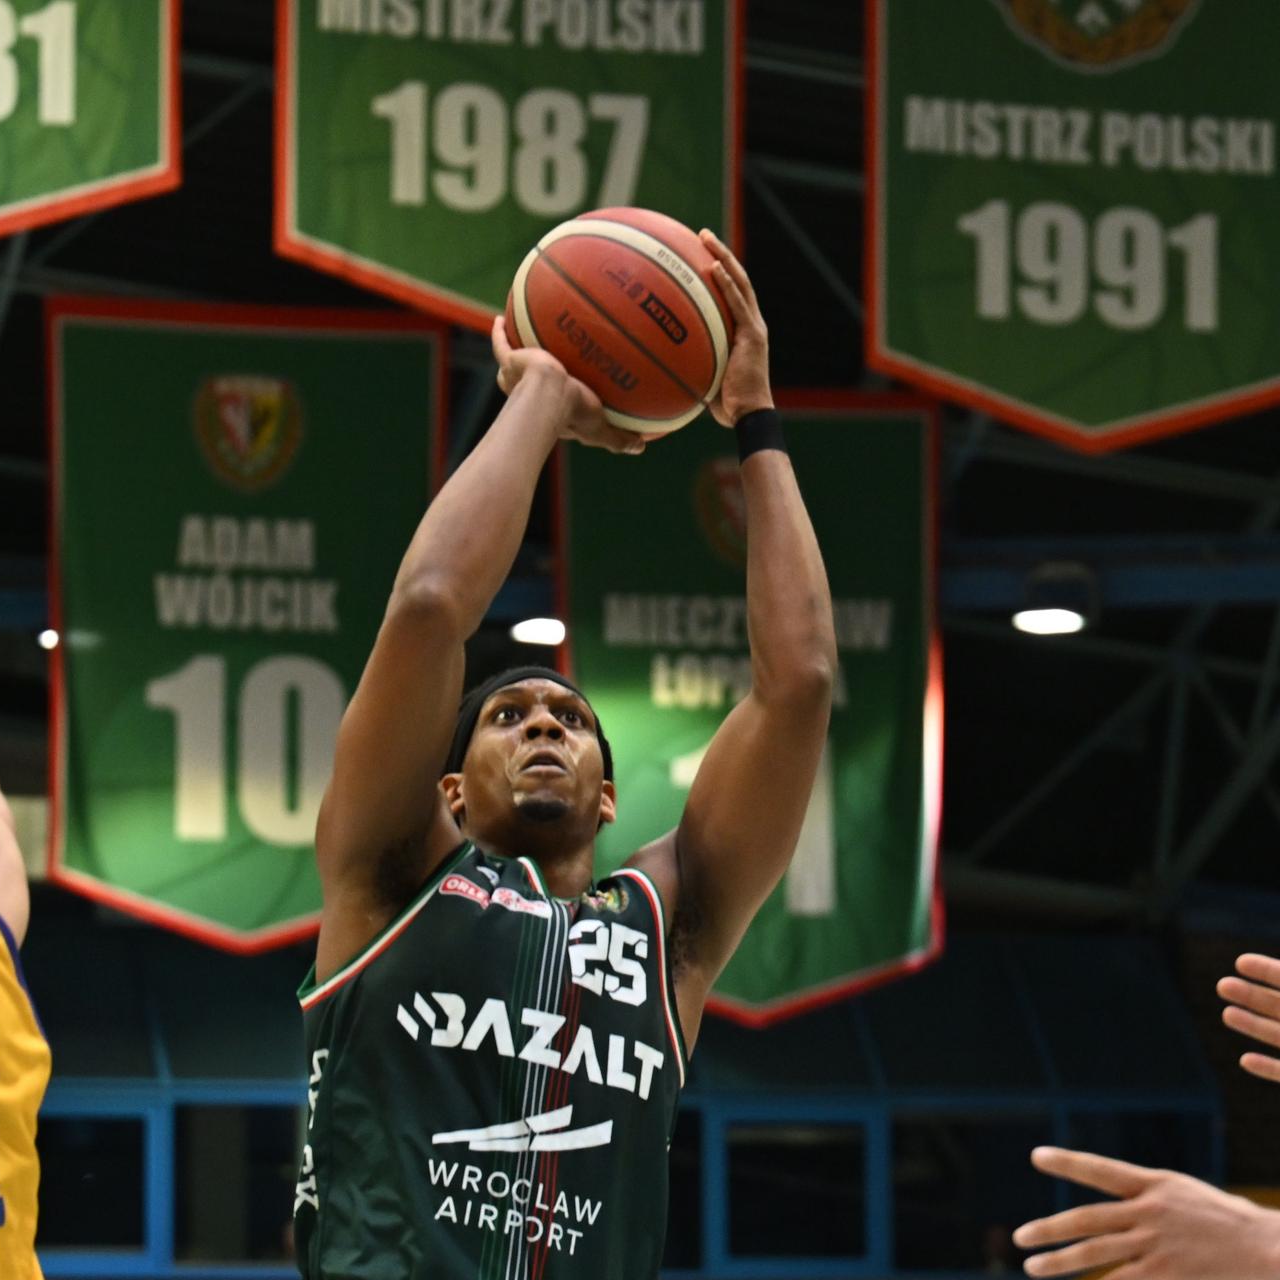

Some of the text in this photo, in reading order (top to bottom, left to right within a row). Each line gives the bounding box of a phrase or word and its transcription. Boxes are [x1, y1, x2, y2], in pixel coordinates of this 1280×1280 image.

[320, 0, 705, 56] MISTRZ POLSKI
[372, 80, 650, 215] 1987
[904, 96, 1274, 176] MISTRZ POLSKI
[957, 200, 1219, 332] 1991
[177, 515, 315, 571] ADAM
[153, 568, 339, 633] WÓJCIK
[144, 654, 348, 848] 10
[568, 918, 649, 1008] 25
[398, 990, 665, 1101] BAZALT
[434, 1196, 584, 1256] AIRPORT
